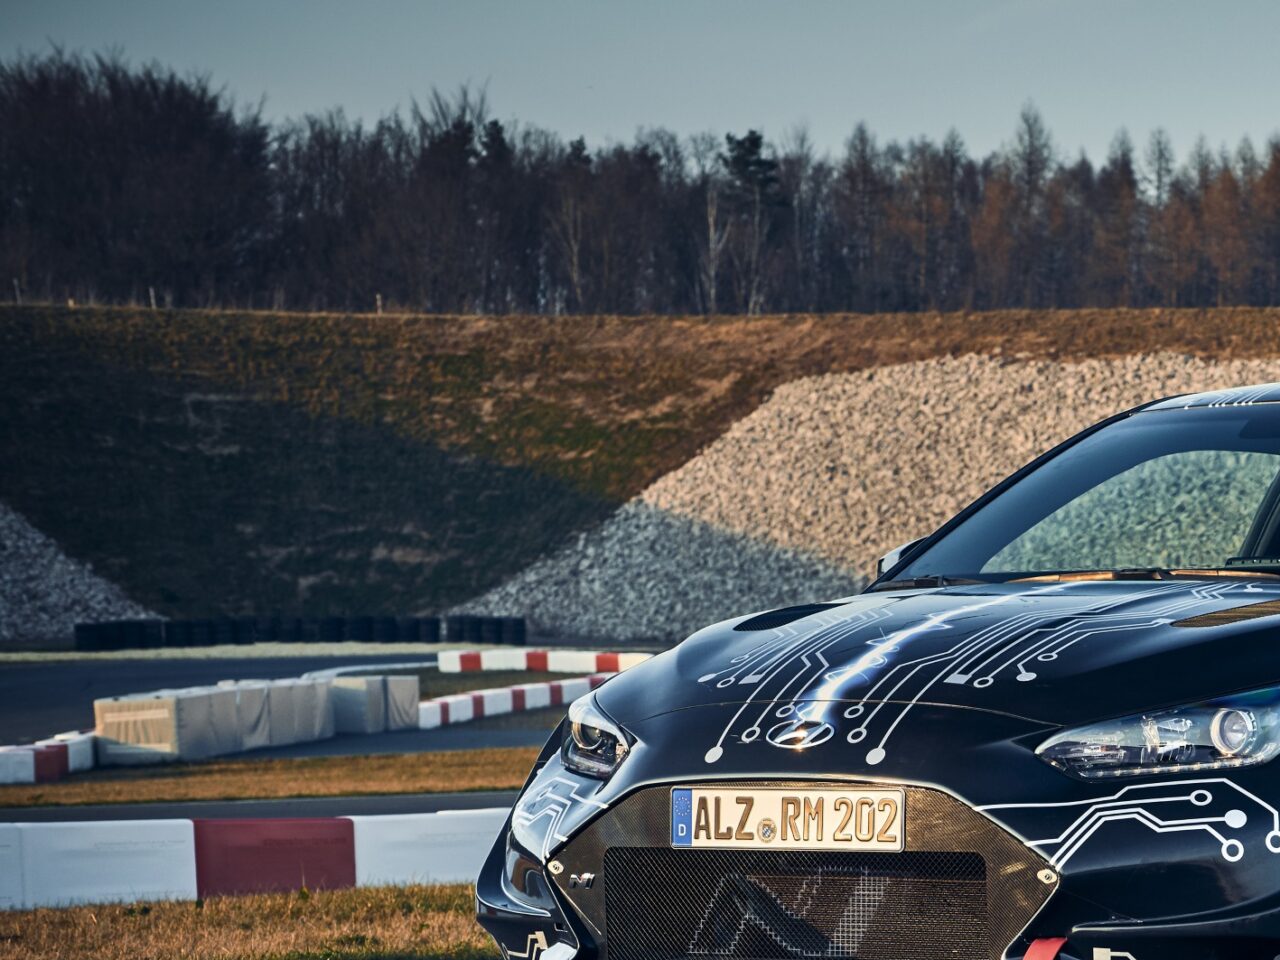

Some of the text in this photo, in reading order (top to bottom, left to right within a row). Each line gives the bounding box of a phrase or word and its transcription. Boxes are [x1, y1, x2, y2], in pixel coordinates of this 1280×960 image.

[677, 823, 687, 837] D
[694, 796, 898, 842] ALZ RM 202
